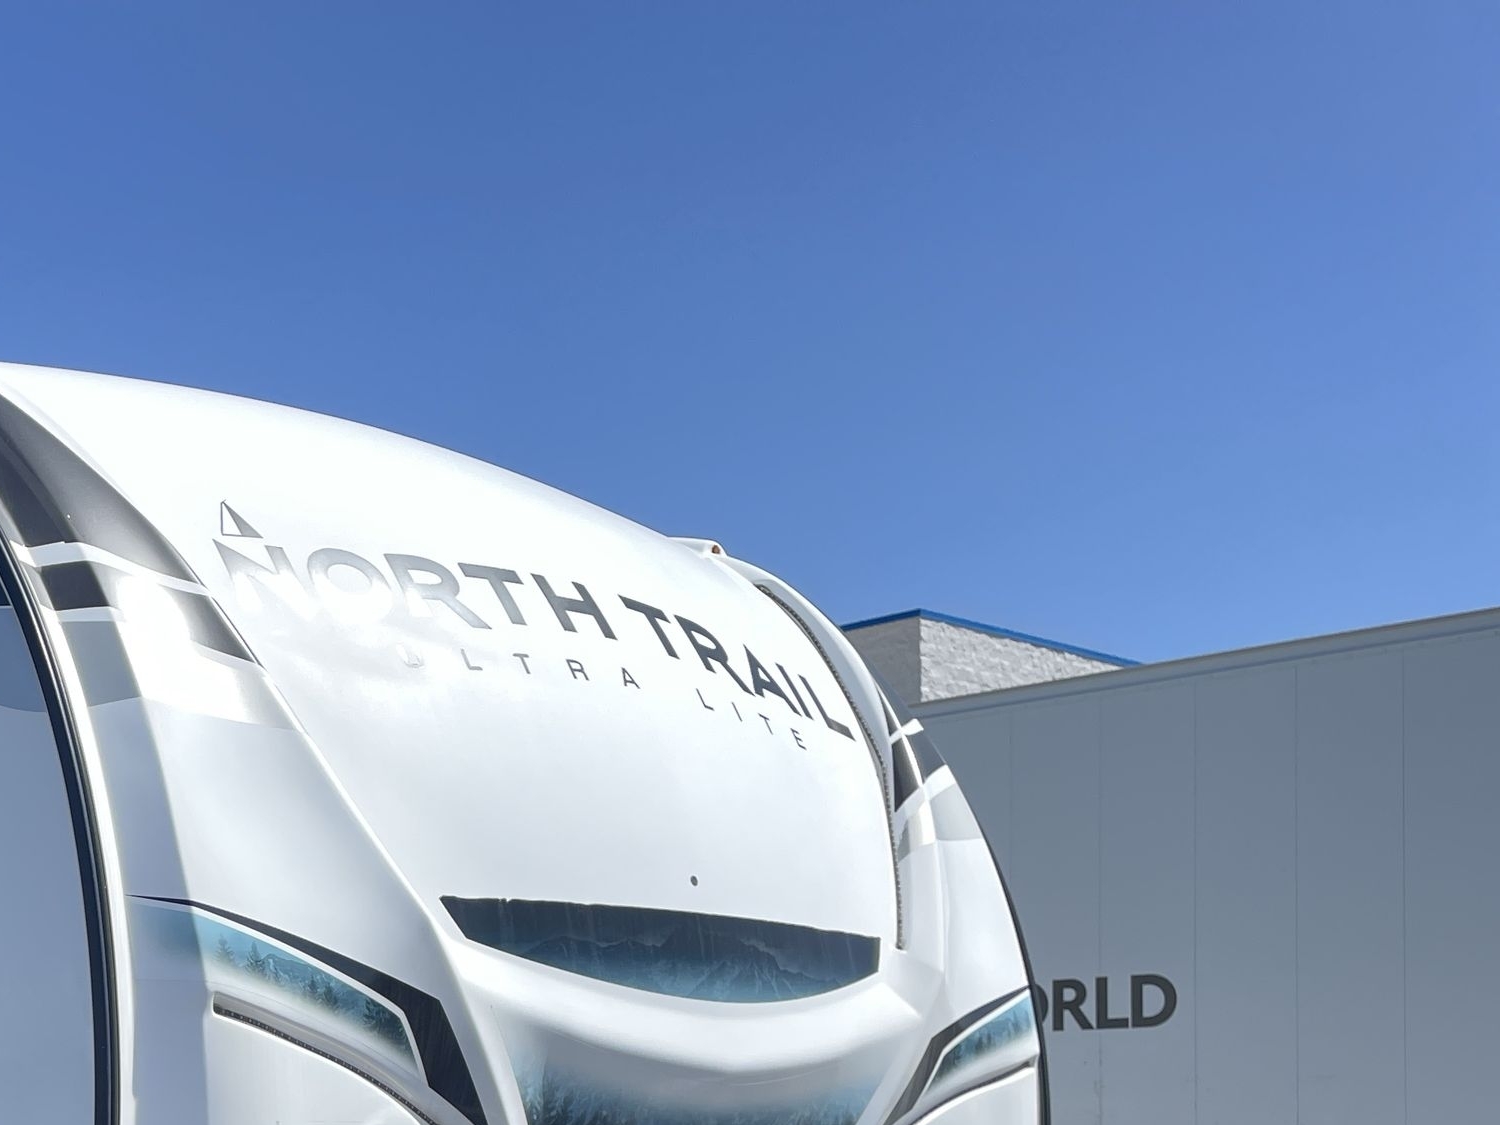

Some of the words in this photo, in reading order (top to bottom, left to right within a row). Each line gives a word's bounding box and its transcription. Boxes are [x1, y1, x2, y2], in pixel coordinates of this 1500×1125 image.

[212, 538, 617, 640] NORTH
[617, 594, 856, 741] TRAIL
[696, 687, 807, 751] LITE
